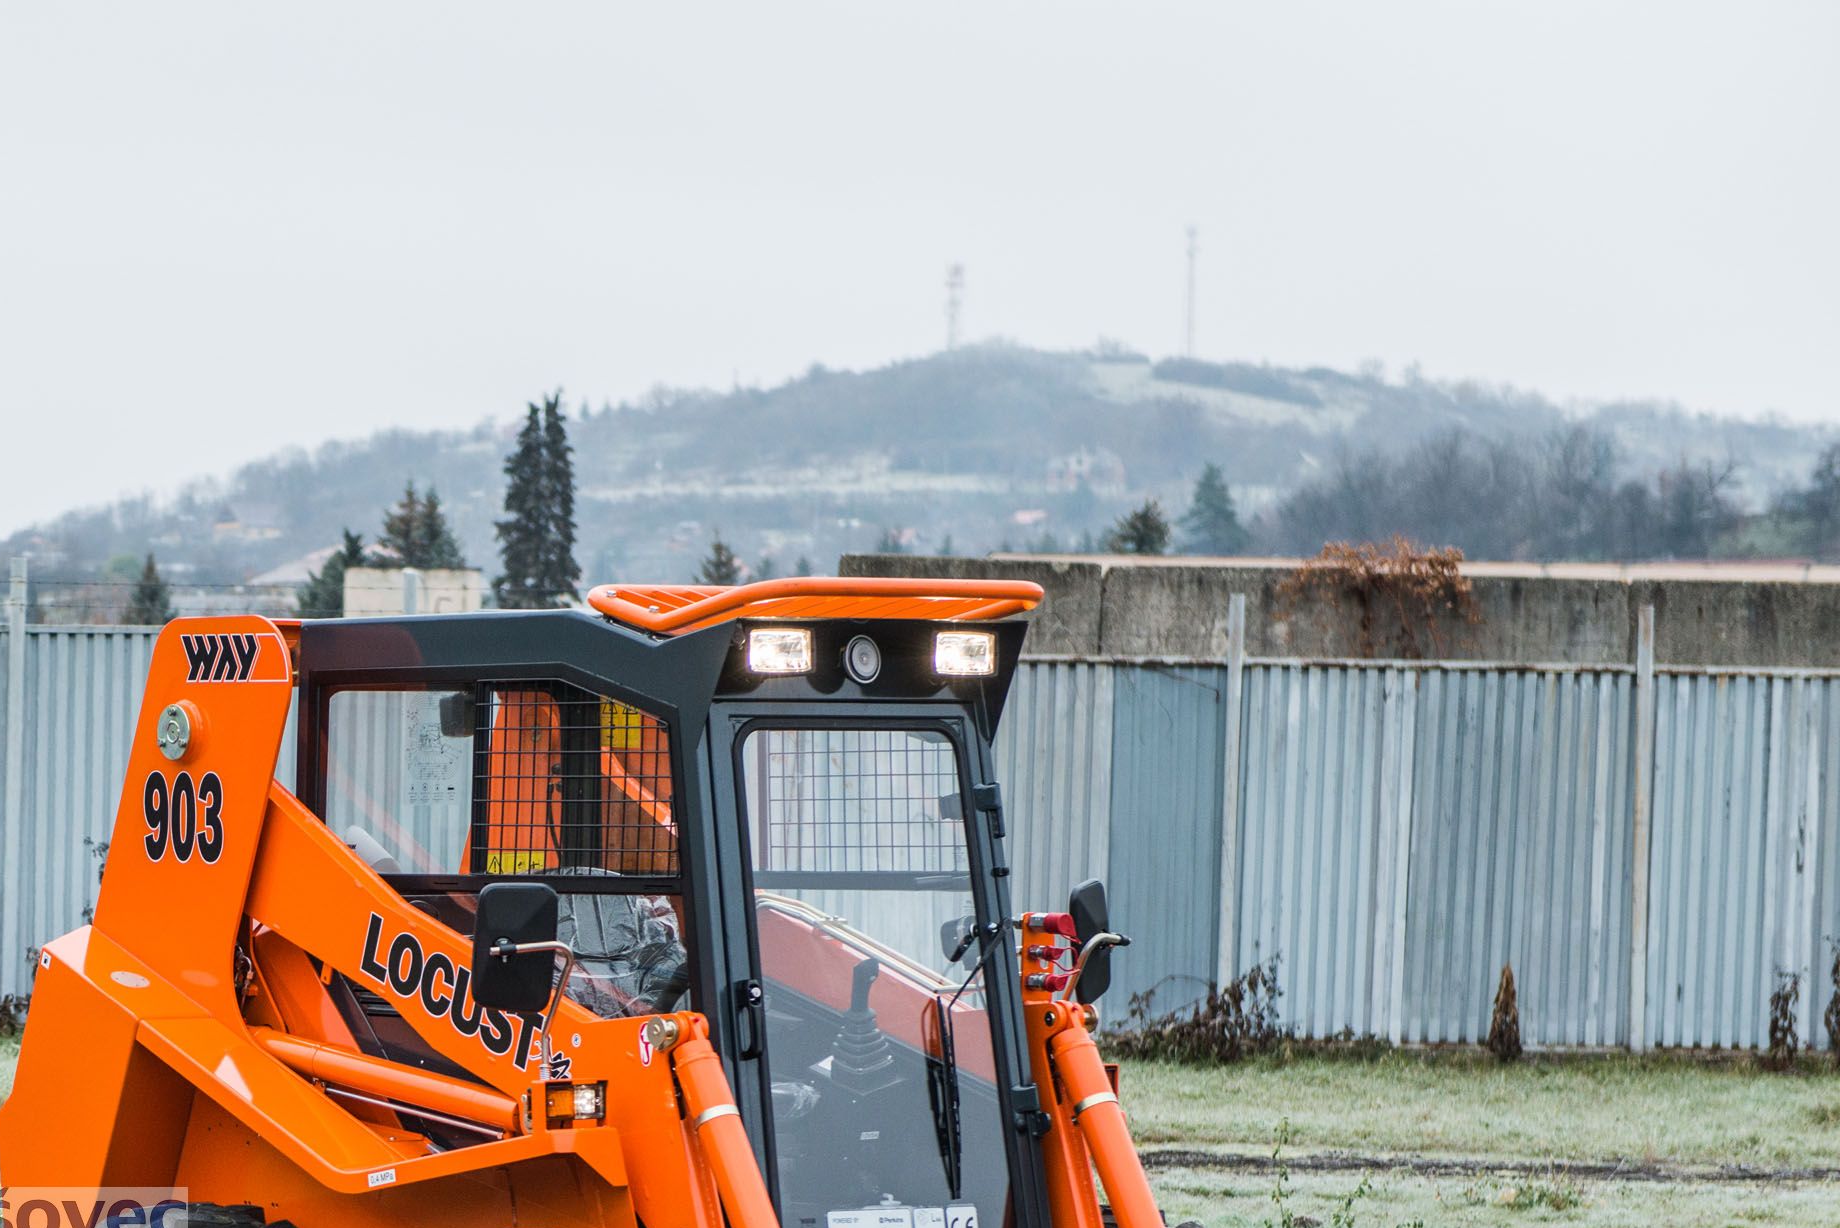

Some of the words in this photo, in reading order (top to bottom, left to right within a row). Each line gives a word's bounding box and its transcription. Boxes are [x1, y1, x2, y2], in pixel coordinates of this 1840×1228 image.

[180, 633, 261, 683] WAY
[143, 770, 224, 864] 903
[360, 911, 547, 1072] LOCUST
